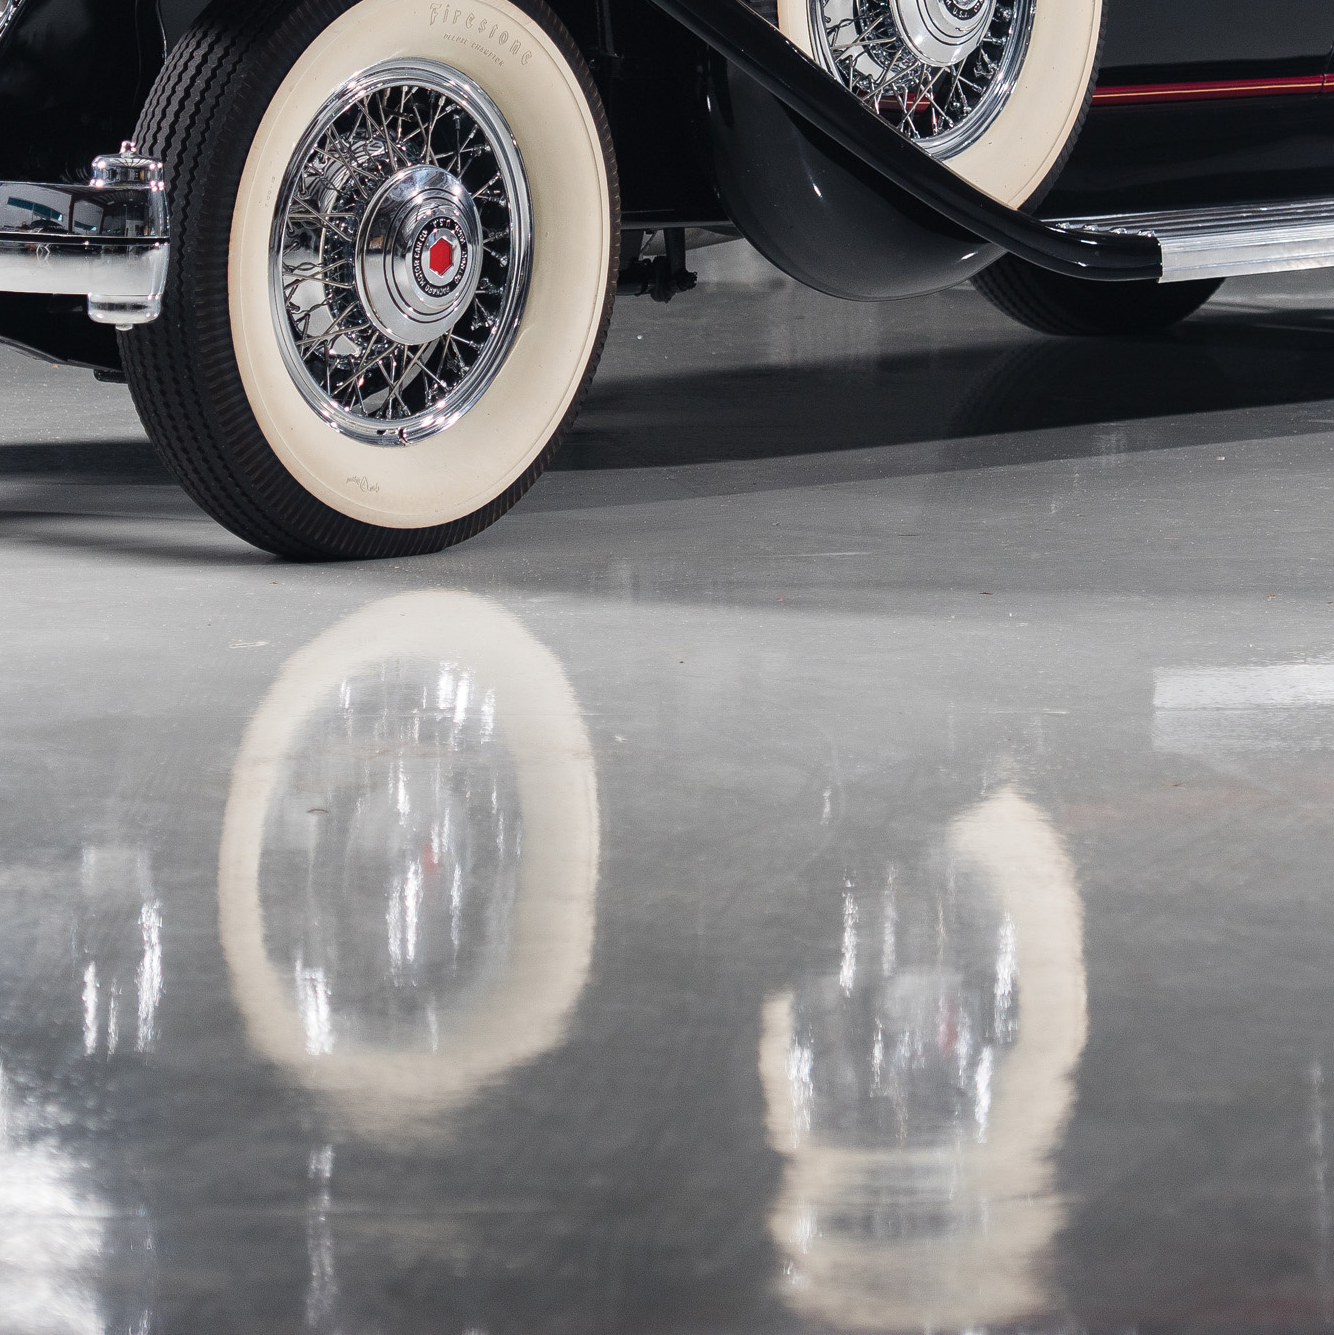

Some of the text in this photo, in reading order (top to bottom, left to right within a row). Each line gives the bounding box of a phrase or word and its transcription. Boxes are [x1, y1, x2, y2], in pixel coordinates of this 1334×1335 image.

[430, 3, 532, 65] Firestone
[414, 241, 422, 258] CAR
[414, 259, 426, 286] MOTOR
[424, 283, 450, 296] PACKARD
